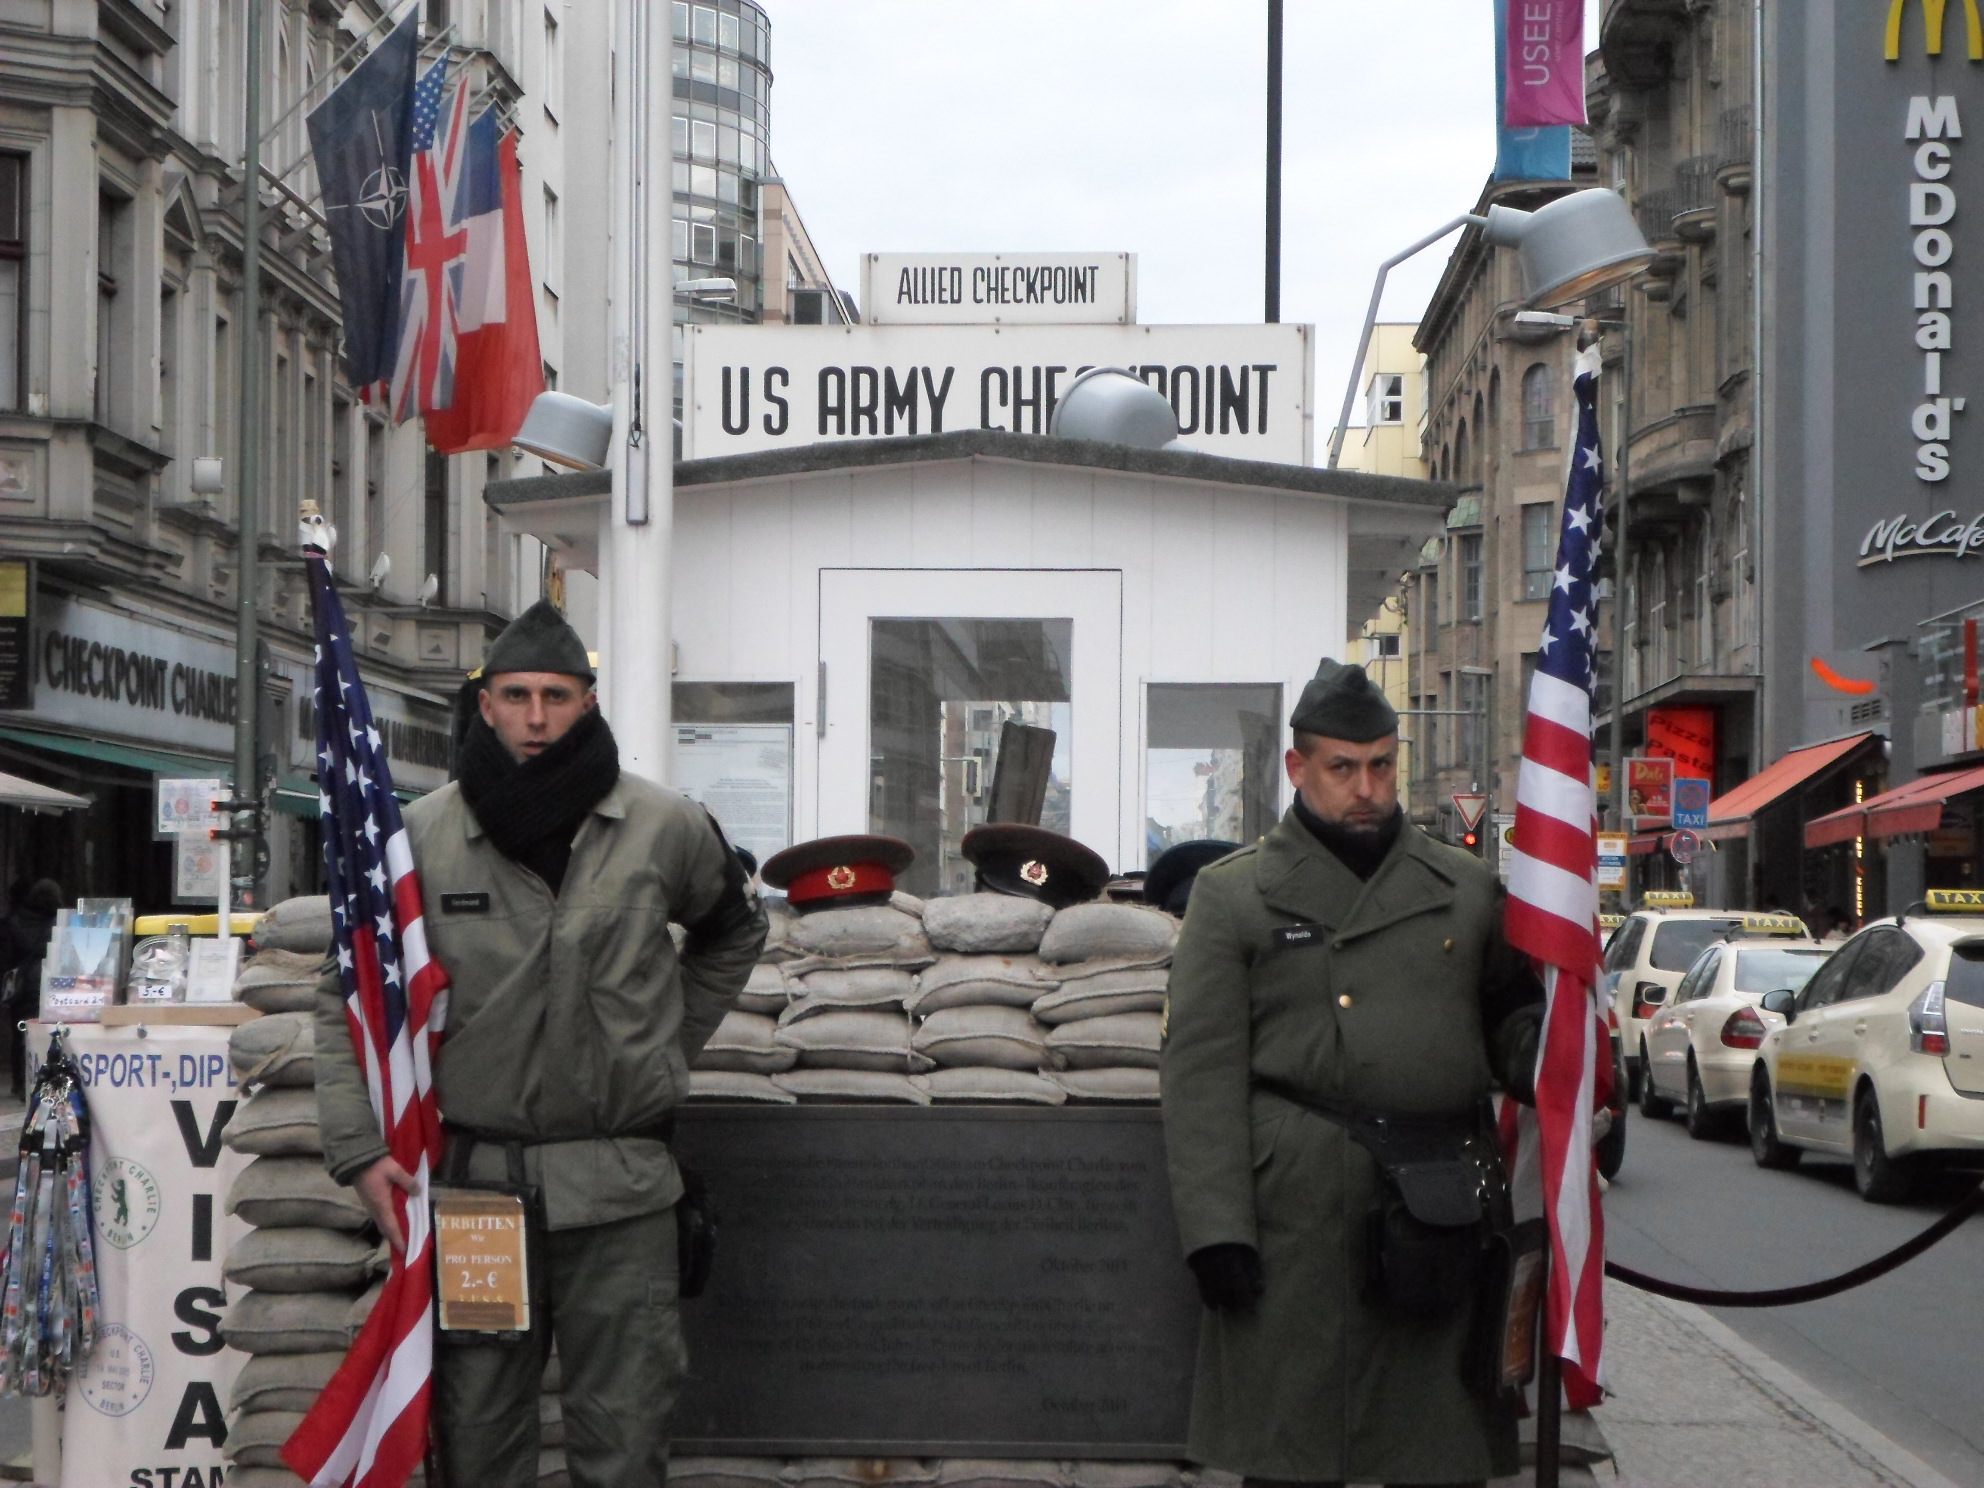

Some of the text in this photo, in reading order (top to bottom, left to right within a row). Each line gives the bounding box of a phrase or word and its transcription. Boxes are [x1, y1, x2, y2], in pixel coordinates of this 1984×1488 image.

[897, 266, 1099, 304] ALLIED CHECKPOINT
[1905, 96, 1966, 482] McDonald's
[721, 363, 1277, 436] US ARMY CHEOINT
[45, 629, 168, 711] CHECKPOINT
[171, 662, 237, 726] CHARLIE
[1650, 714, 1712, 748] Pizza
[1649, 738, 1713, 773] Pasta
[1676, 813, 1704, 825] TAXI
[1654, 892, 1687, 900] TAXI
[1753, 918, 1793, 928] TAXI
[128, 1165, 157, 1214] CHARLIE
[441, 1215, 516, 1230] ERBITTEN
[164, 1100, 238, 1450] VISA
[445, 1254, 513, 1264] PRO PERSON
